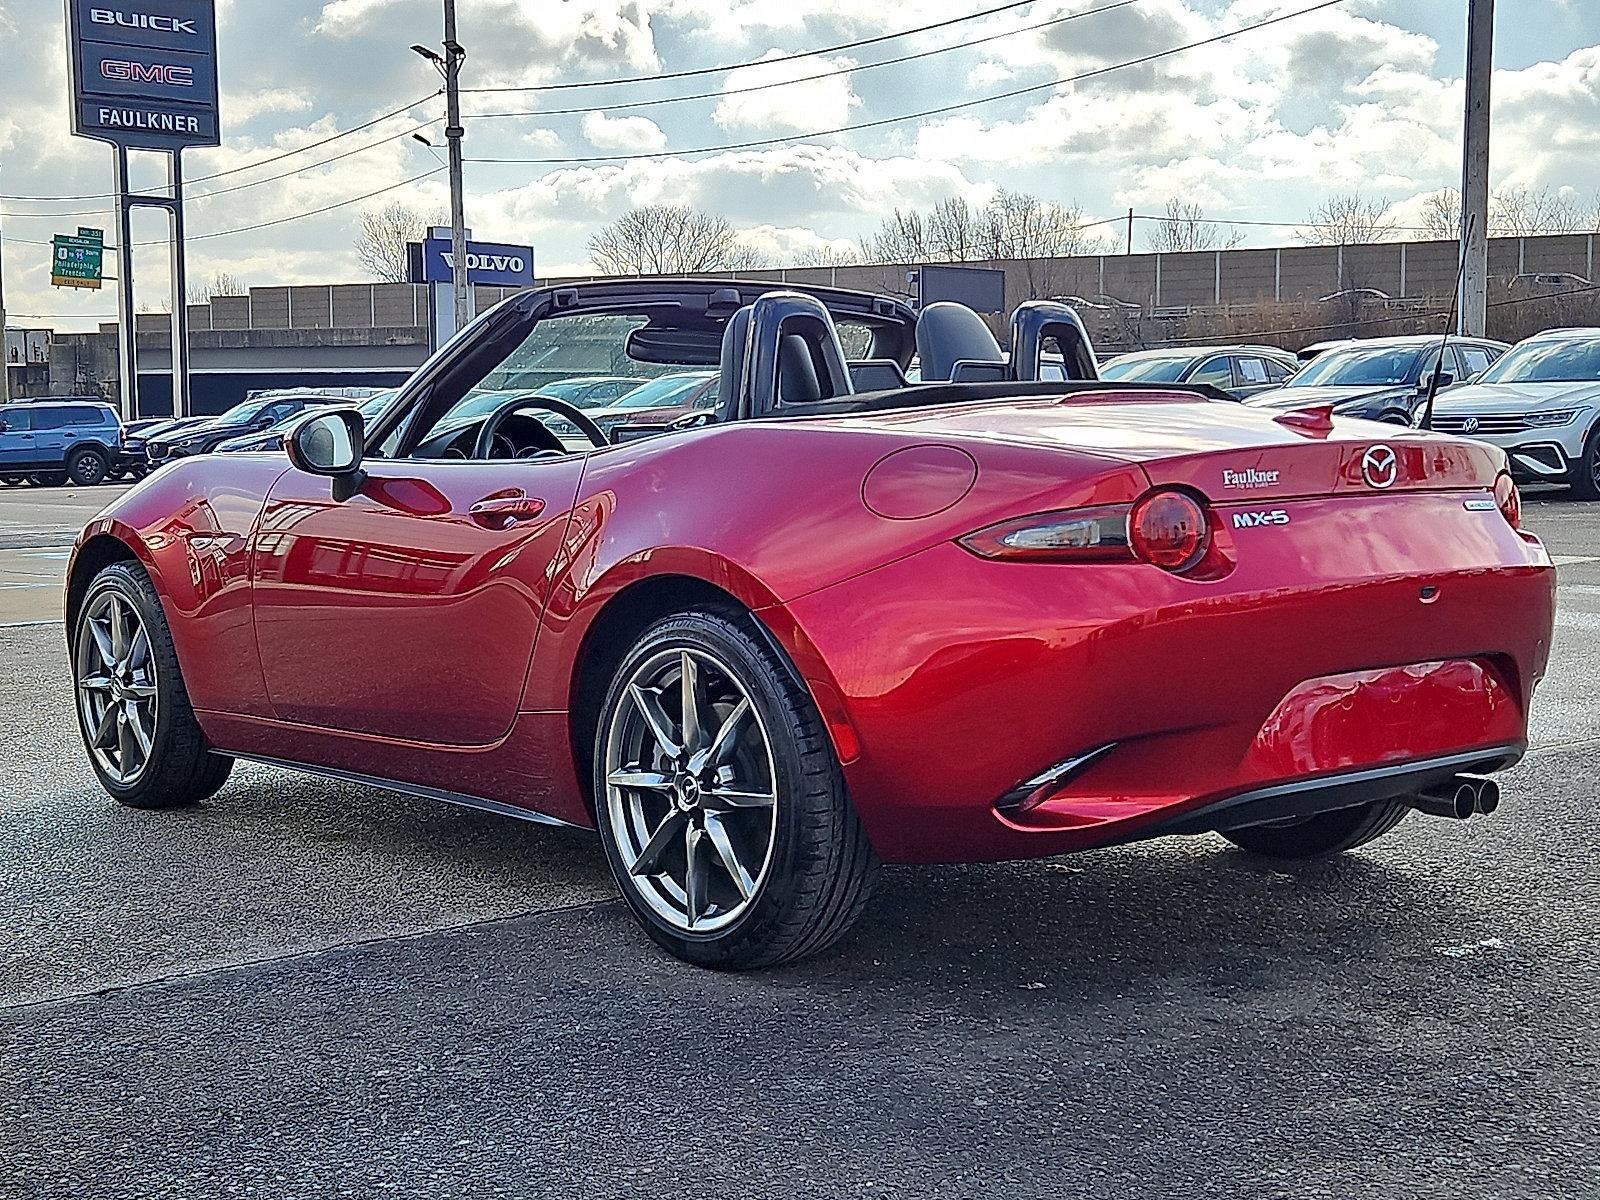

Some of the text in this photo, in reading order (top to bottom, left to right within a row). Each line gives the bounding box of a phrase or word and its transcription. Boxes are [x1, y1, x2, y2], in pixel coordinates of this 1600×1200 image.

[90, 8, 197, 34] BUICK
[100, 59, 193, 86] GMC
[99, 109, 199, 132] FAULKNER
[440, 252, 524, 272] VOLVO
[61, 268, 86, 277] Trenton
[1222, 468, 1280, 485] Faulkner
[1232, 510, 1290, 528] MX-5
